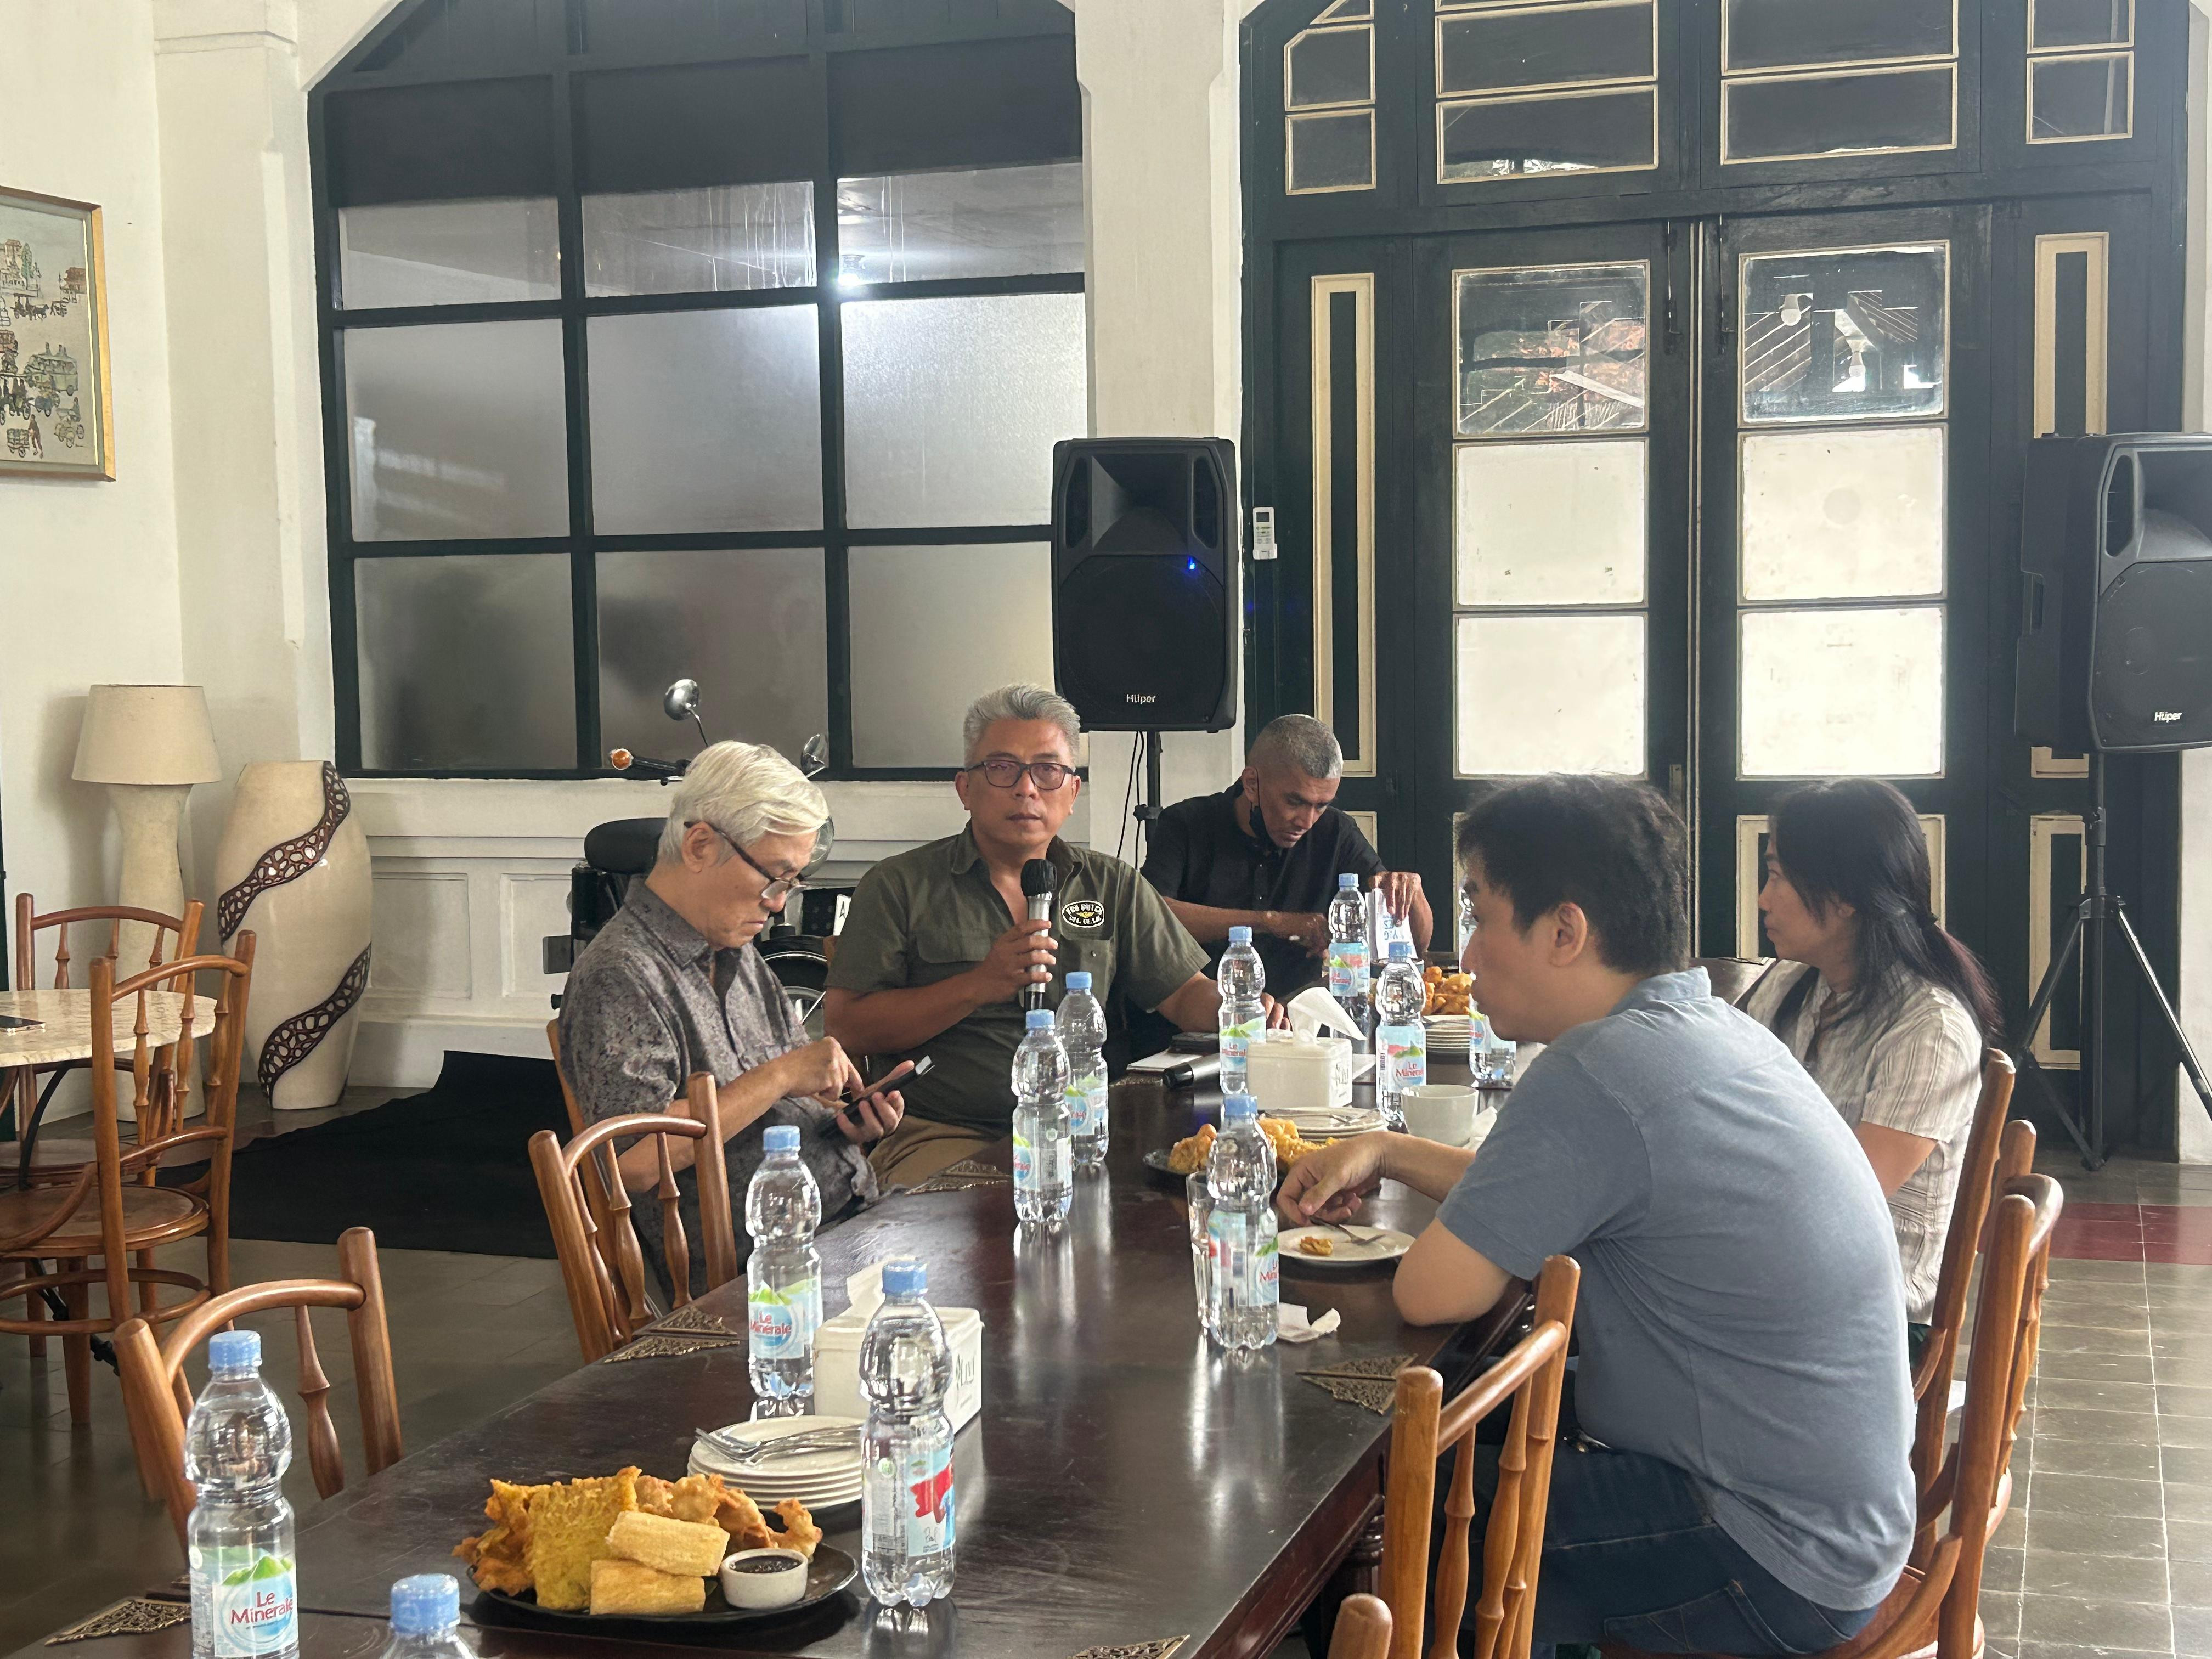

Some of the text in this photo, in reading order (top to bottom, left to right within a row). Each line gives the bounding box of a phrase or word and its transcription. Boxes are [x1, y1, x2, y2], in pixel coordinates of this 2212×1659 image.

[759, 1311, 772, 1324] Le
[256, 1591, 275, 1607] Le
[230, 1596, 293, 1624] Minerale
